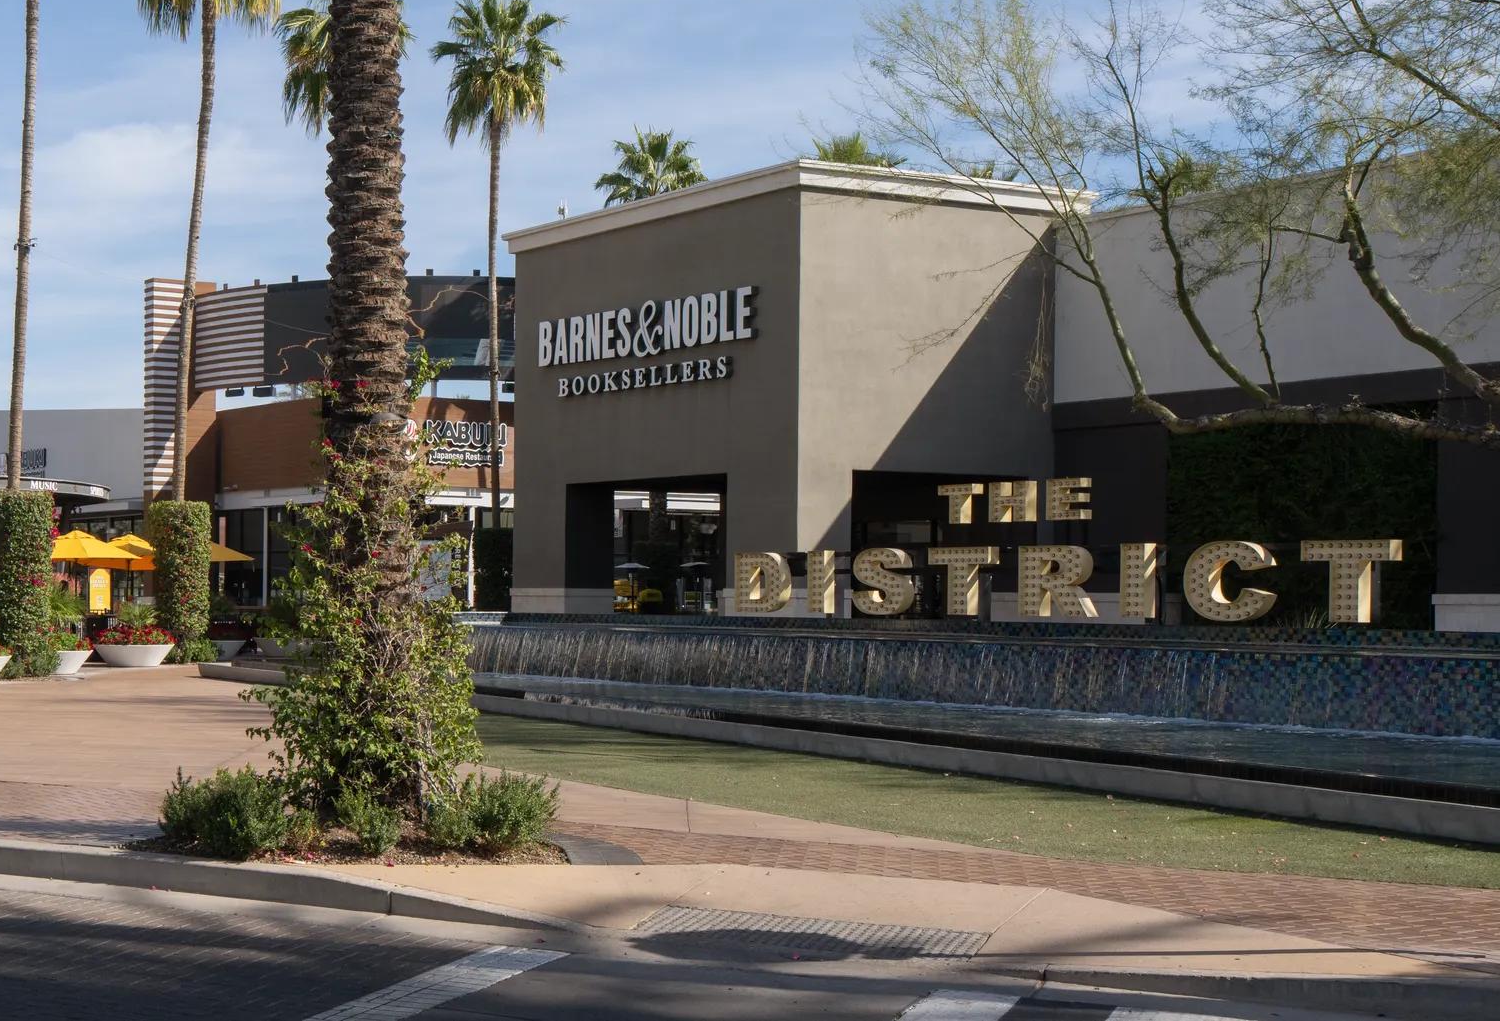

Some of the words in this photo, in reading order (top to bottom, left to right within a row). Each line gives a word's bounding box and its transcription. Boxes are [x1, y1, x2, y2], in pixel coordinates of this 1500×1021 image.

[558, 356, 729, 397] BOOKSELLERS
[30, 480, 58, 491] MUSIC
[937, 477, 1093, 524] THE
[734, 539, 1403, 623] DISTRICT
